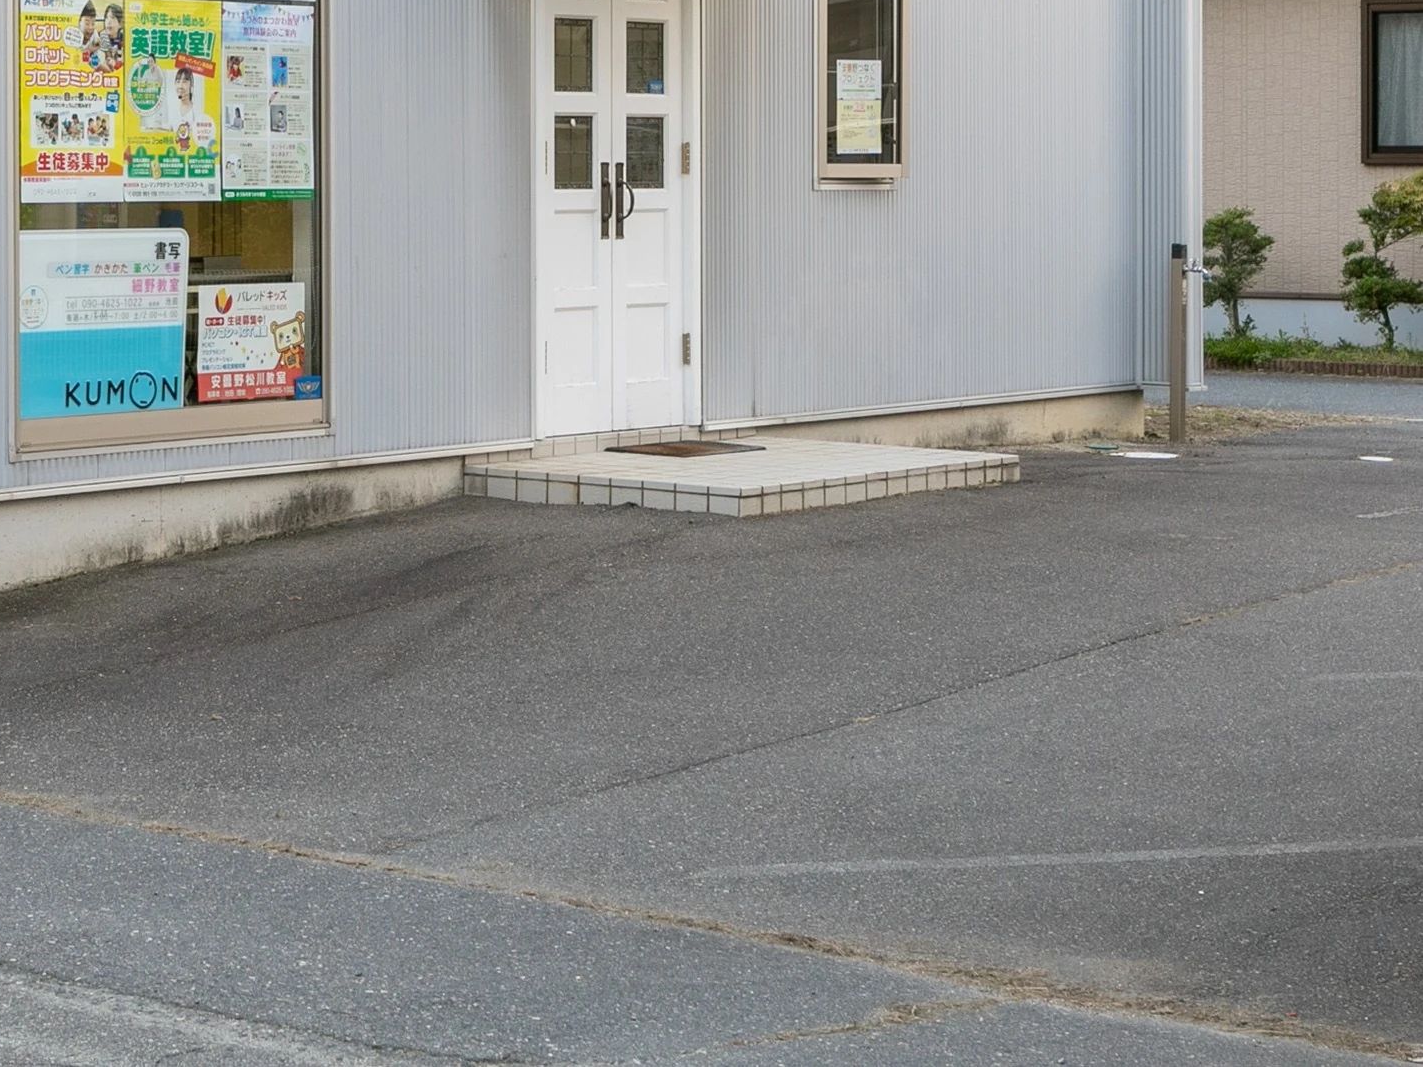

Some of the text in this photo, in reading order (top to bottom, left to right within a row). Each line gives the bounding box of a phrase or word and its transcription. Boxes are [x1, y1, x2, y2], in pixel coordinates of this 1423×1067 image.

[24, 23, 61, 41] パズル
[131, 28, 214, 57] 英語教室!
[24, 47, 70, 64] ロボット
[37, 152, 109, 171] 生徒募集中
[155, 241, 181, 260] 書写
[55, 263, 90, 275] ペン習字
[94, 263, 128, 274] かきかた
[132, 278, 180, 294] 細野教室
[65, 372, 179, 409] KUMON
